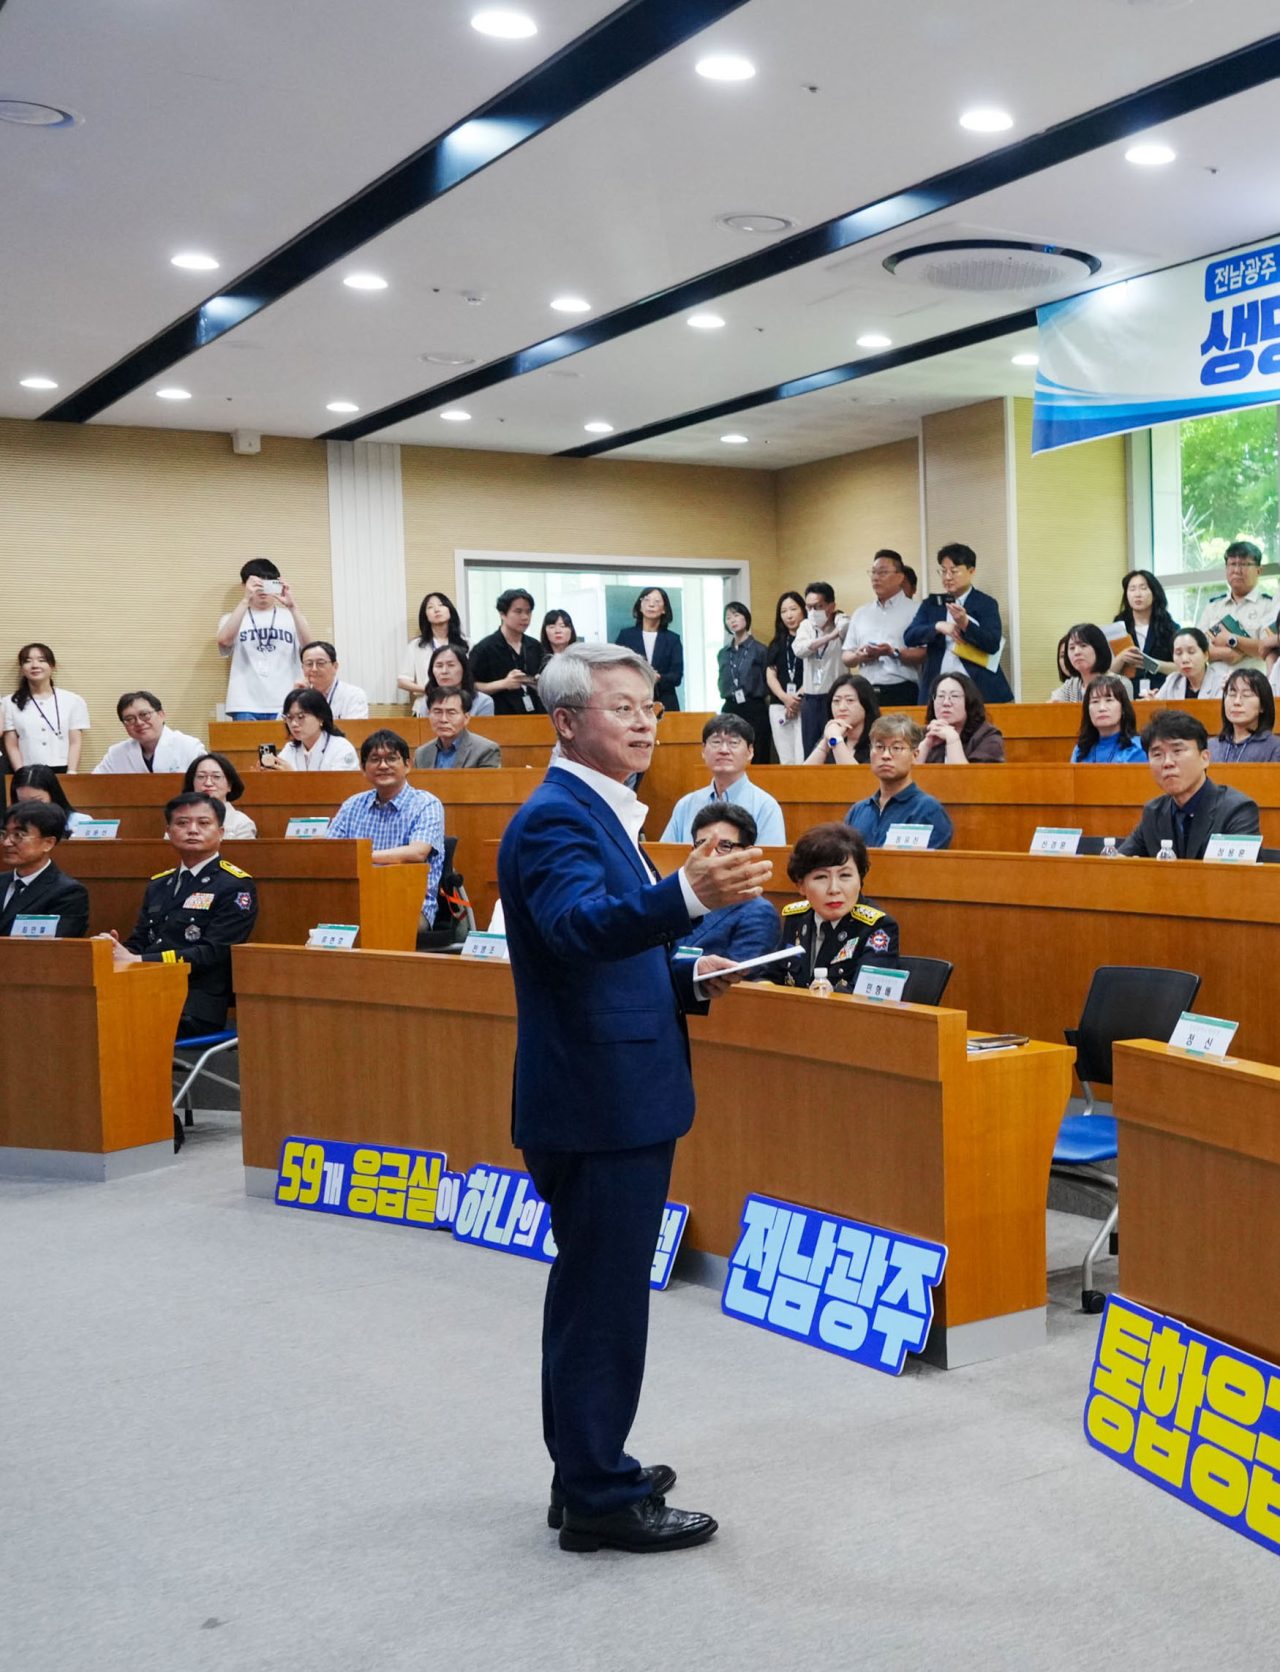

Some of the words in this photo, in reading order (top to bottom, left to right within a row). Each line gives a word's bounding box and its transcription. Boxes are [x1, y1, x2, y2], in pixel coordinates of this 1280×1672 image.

[1214, 253, 1277, 294] 전남광주
[240, 628, 293, 644] STUDIO
[278, 1142, 345, 1206] 59개
[455, 1169, 545, 1247] 하나의
[725, 1200, 942, 1367] 전남광주
